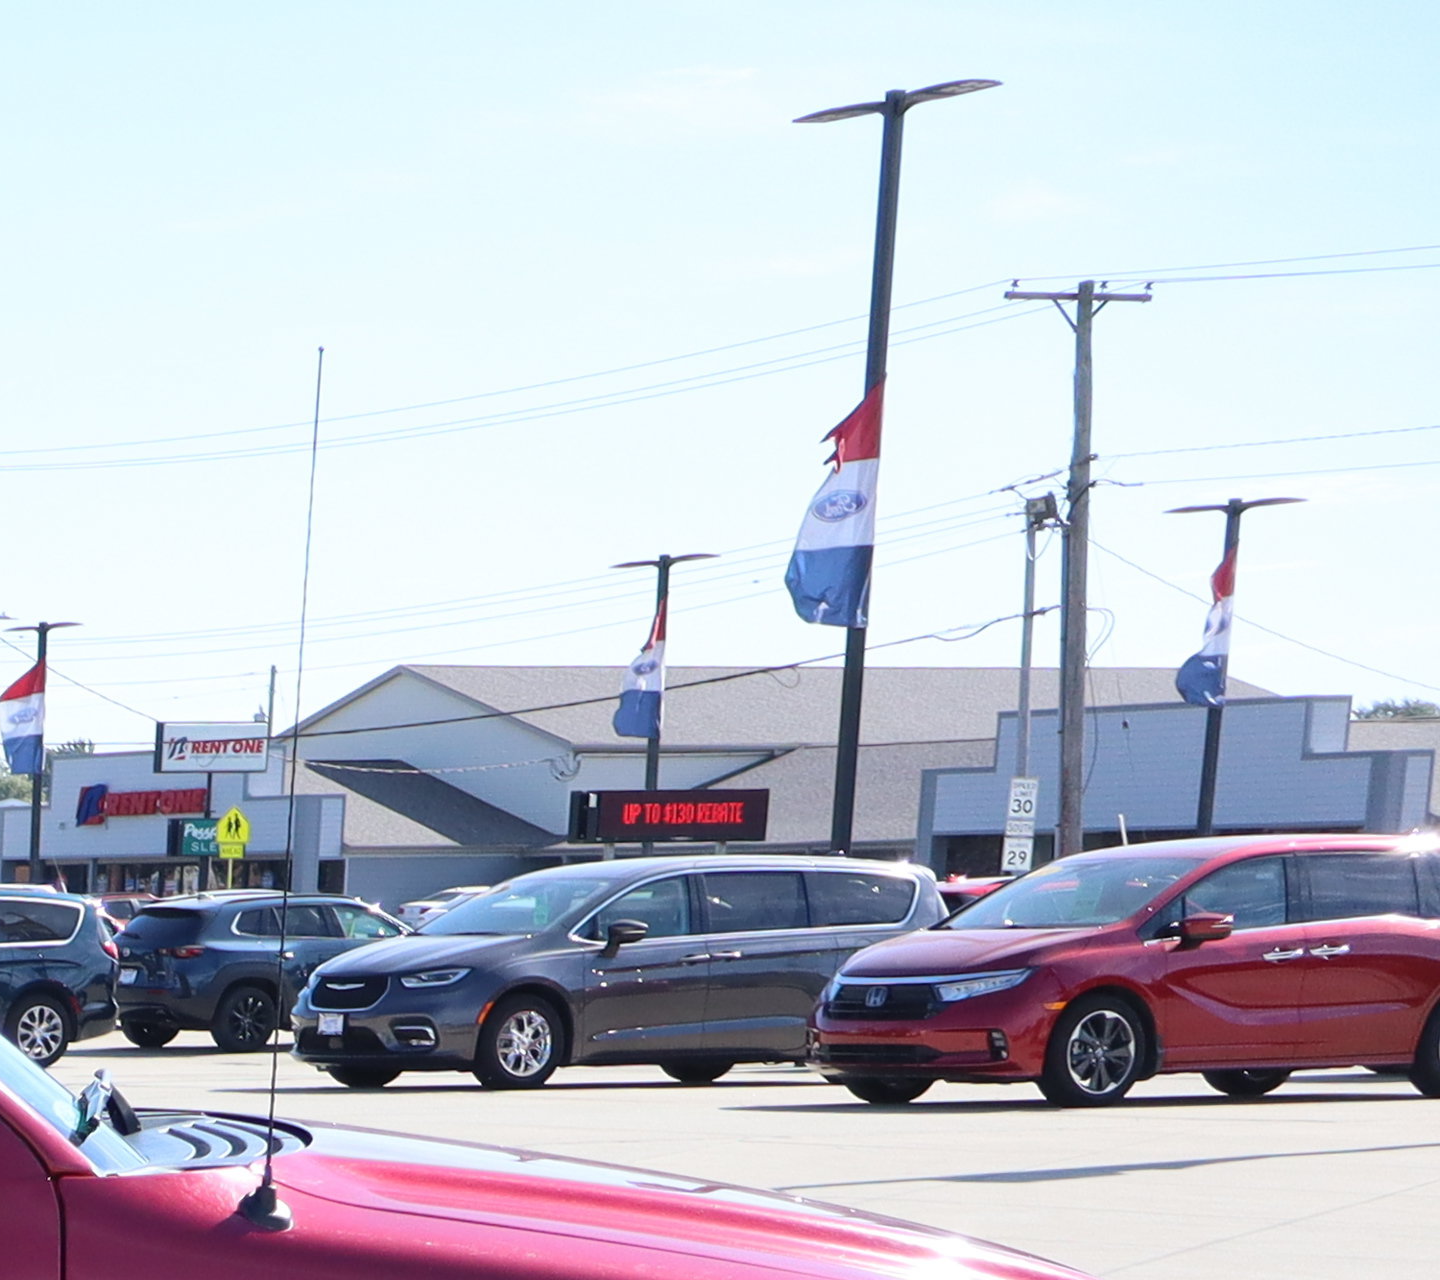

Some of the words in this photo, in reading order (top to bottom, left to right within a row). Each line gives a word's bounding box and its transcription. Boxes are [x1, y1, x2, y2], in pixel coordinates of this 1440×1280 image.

[191, 740, 231, 753] RENT
[232, 739, 264, 753] ONE
[107, 792, 159, 815] RENT
[161, 789, 206, 814] ONE
[1011, 799, 1033, 814] 30
[623, 803, 642, 824] UP
[644, 803, 661, 824] TO
[697, 802, 744, 823] REBATE
[1007, 822, 1033, 833] SOUTH
[1007, 850, 1028, 865] 29
